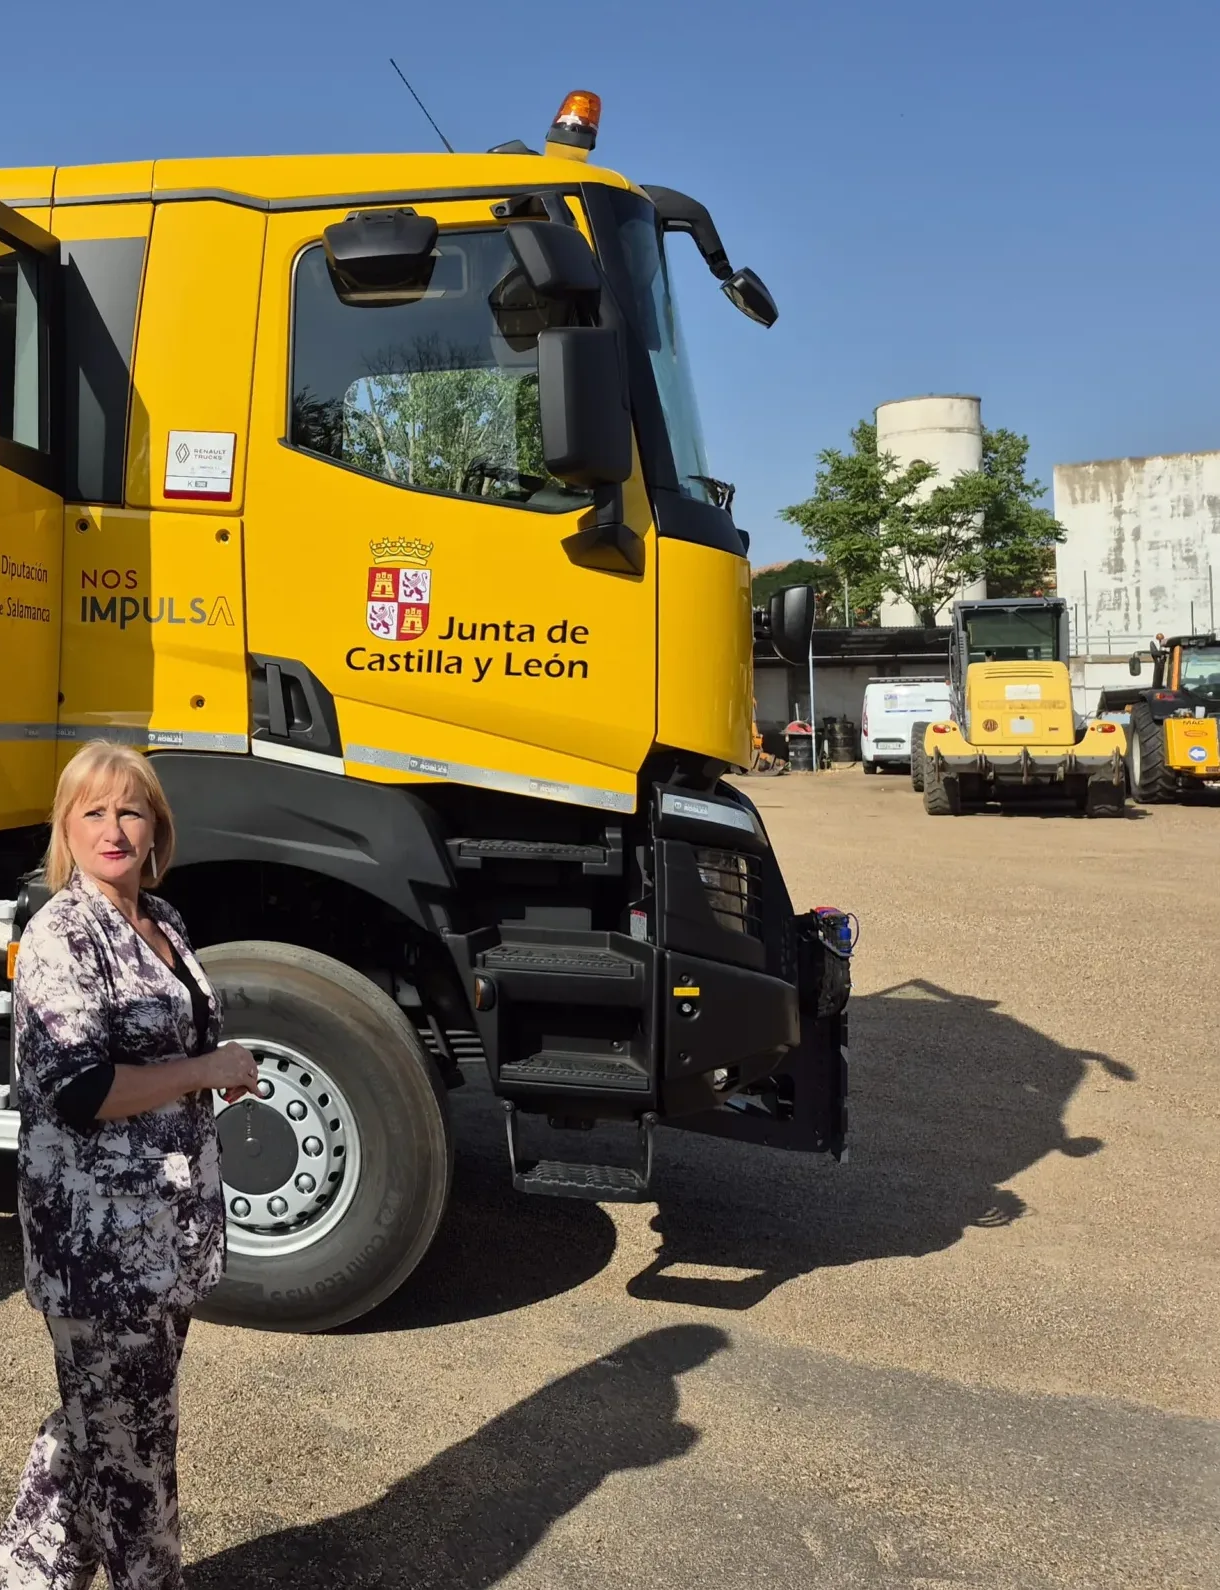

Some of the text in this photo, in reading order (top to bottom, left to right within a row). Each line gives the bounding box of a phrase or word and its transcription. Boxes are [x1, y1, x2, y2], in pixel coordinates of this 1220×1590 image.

[1, 554, 48, 583] Diputación
[81, 569, 138, 589] NOS
[6, 597, 51, 622] Salamanca
[438, 616, 590, 644] Junta de
[345, 647, 589, 683] Castilla y León
